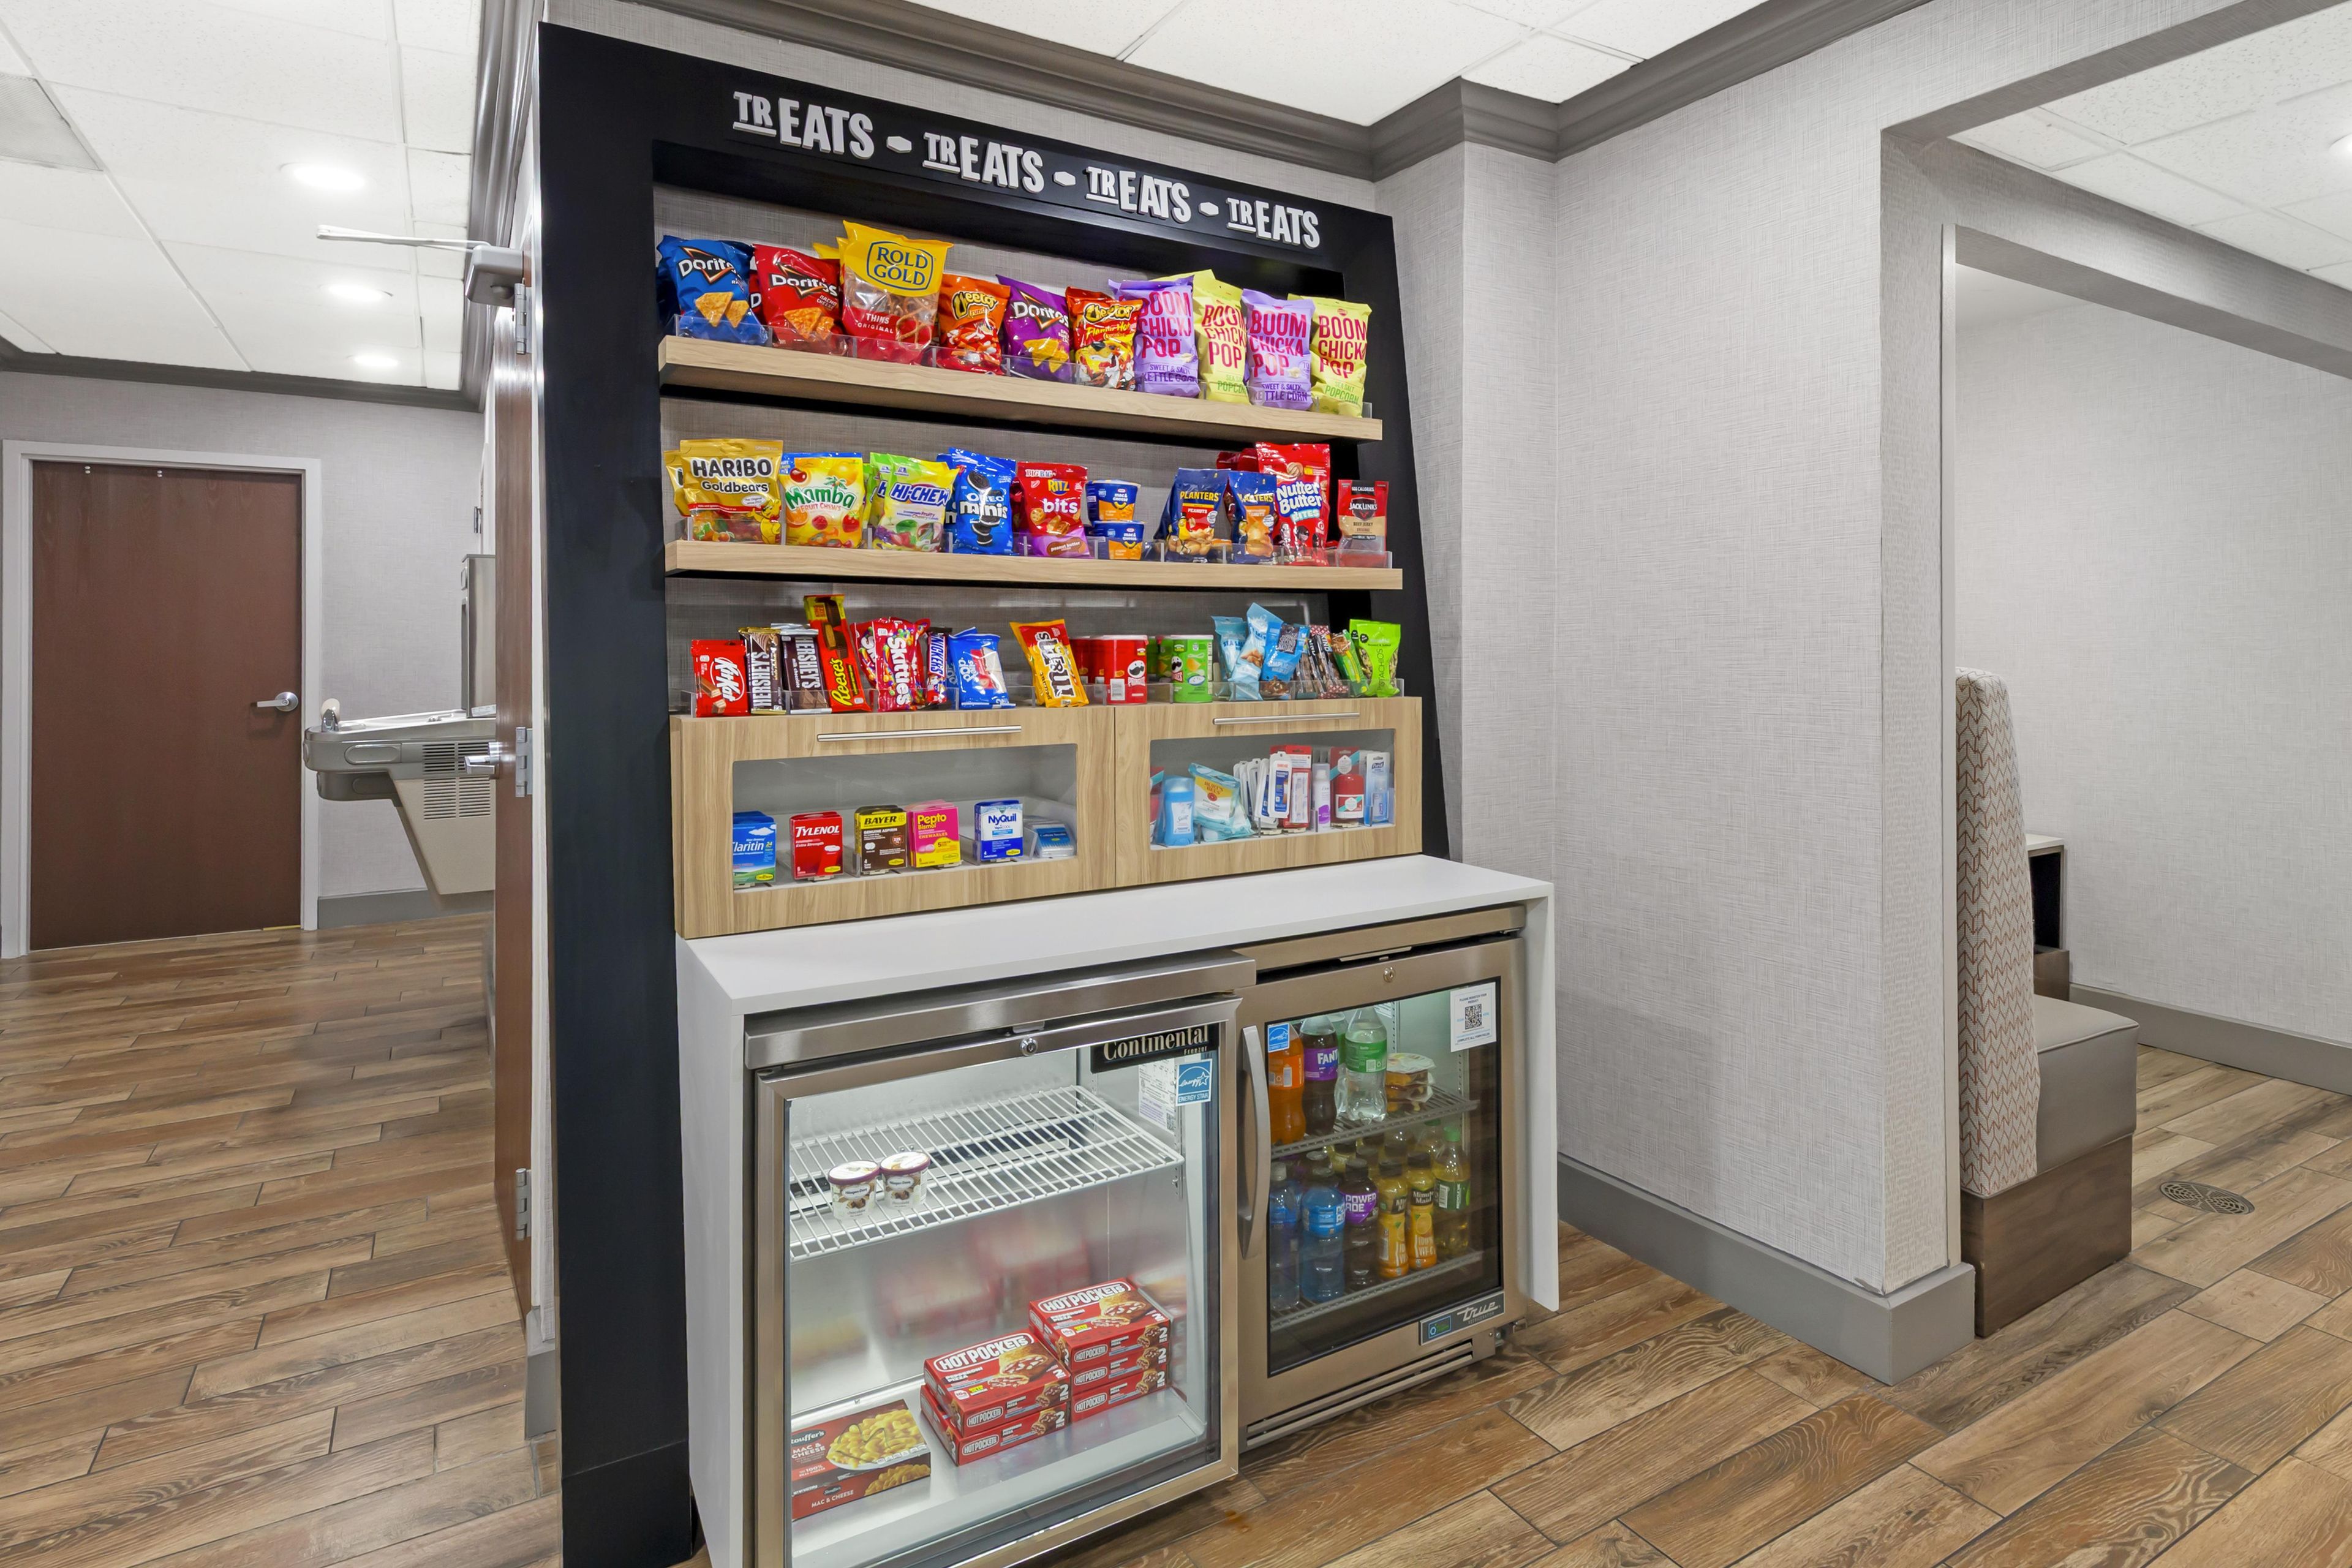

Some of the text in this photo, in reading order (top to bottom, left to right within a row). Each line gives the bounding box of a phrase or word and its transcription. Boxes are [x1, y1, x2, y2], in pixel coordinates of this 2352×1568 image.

[733, 91, 875, 159] TREATS
[922, 130, 1044, 194] TREATS
[1085, 165, 1191, 224] TREATS
[1226, 196, 1320, 249] TREATS
[876, 246, 929, 270] ROLD
[678, 258, 736, 277] Dorito
[873, 264, 926, 286] GOLD
[771, 273, 838, 297] Doritos
[952, 292, 998, 320] Cheetos
[1012, 301, 1069, 327] Doritos
[858, 322, 894, 334] ORIGINAL
[865, 313, 891, 325] THINS
[1250, 310, 1307, 337] BOOM
[1318, 315, 1366, 341] BOOM
[1142, 337, 1182, 359] POP
[1250, 334, 1304, 357] CHICKA
[1209, 341, 1242, 369] POP
[1254, 353, 1289, 378] POP
[1319, 358, 1355, 379] POP
[1286, 391, 1308, 402] CORN
[1325, 385, 1359, 404] POPCORN
[692, 458, 772, 477] HARIBO
[701, 481, 769, 493] Goldbears
[1047, 479, 1070, 492] RITZ
[1276, 481, 1321, 502] Nutter
[785, 486, 857, 511] Mamba
[891, 484, 951, 506] HI-CHEW
[1180, 491, 1220, 502] PLANTERS
[1279, 494, 1322, 514] Butter
[800, 503, 819, 512] FRUIT
[1042, 498, 1079, 514] bits
[1321, 635, 1330, 652] KIND
[794, 636, 821, 689] HERSHEY'S
[929, 635, 945, 676] NICKERS
[751, 651, 772, 708] HERSHEY'S
[887, 636, 911, 706] Skittles
[829, 657, 853, 706] Reese's
[864, 816, 897, 825] BAYER
[918, 813, 947, 824] Pepto
[988, 813, 1017, 826] NyQuil
[795, 825, 840, 838] TYLENOL
[733, 841, 764, 852] laritin
[1103, 1025, 1208, 1061] Continental
[1184, 1046, 1208, 1055] Freezer
[1317, 1048, 1338, 1065] FANT
[1178, 1092, 1209, 1102] ENERGY STAR
[1345, 1193, 1377, 1205] POWER
[1042, 1284, 1126, 1311] HOT POCKETS
[1159, 1327, 1167, 1339] 2
[938, 1335, 1030, 1371] HOT POCKETS
[1076, 1351, 1086, 1360] HOT
[1158, 1348, 1166, 1360] 2
[1076, 1374, 1086, 1384] HOT
[1157, 1371, 1165, 1384] 2
[1060, 1384, 1069, 1396] 2
[1076, 1401, 1086, 1411] HOT
[968, 1408, 1001, 1426] HOT POCKETS
[1055, 1411, 1065, 1423] 2
[791, 1431, 825, 1444] touffer's
[791, 1446, 826, 1459] CHEESE
[793, 1446, 813, 1454] MAC
[964, 1444, 975, 1453] HOT
[811, 1499, 825, 1508] MAC
[832, 1490, 854, 1501] CHEESE
